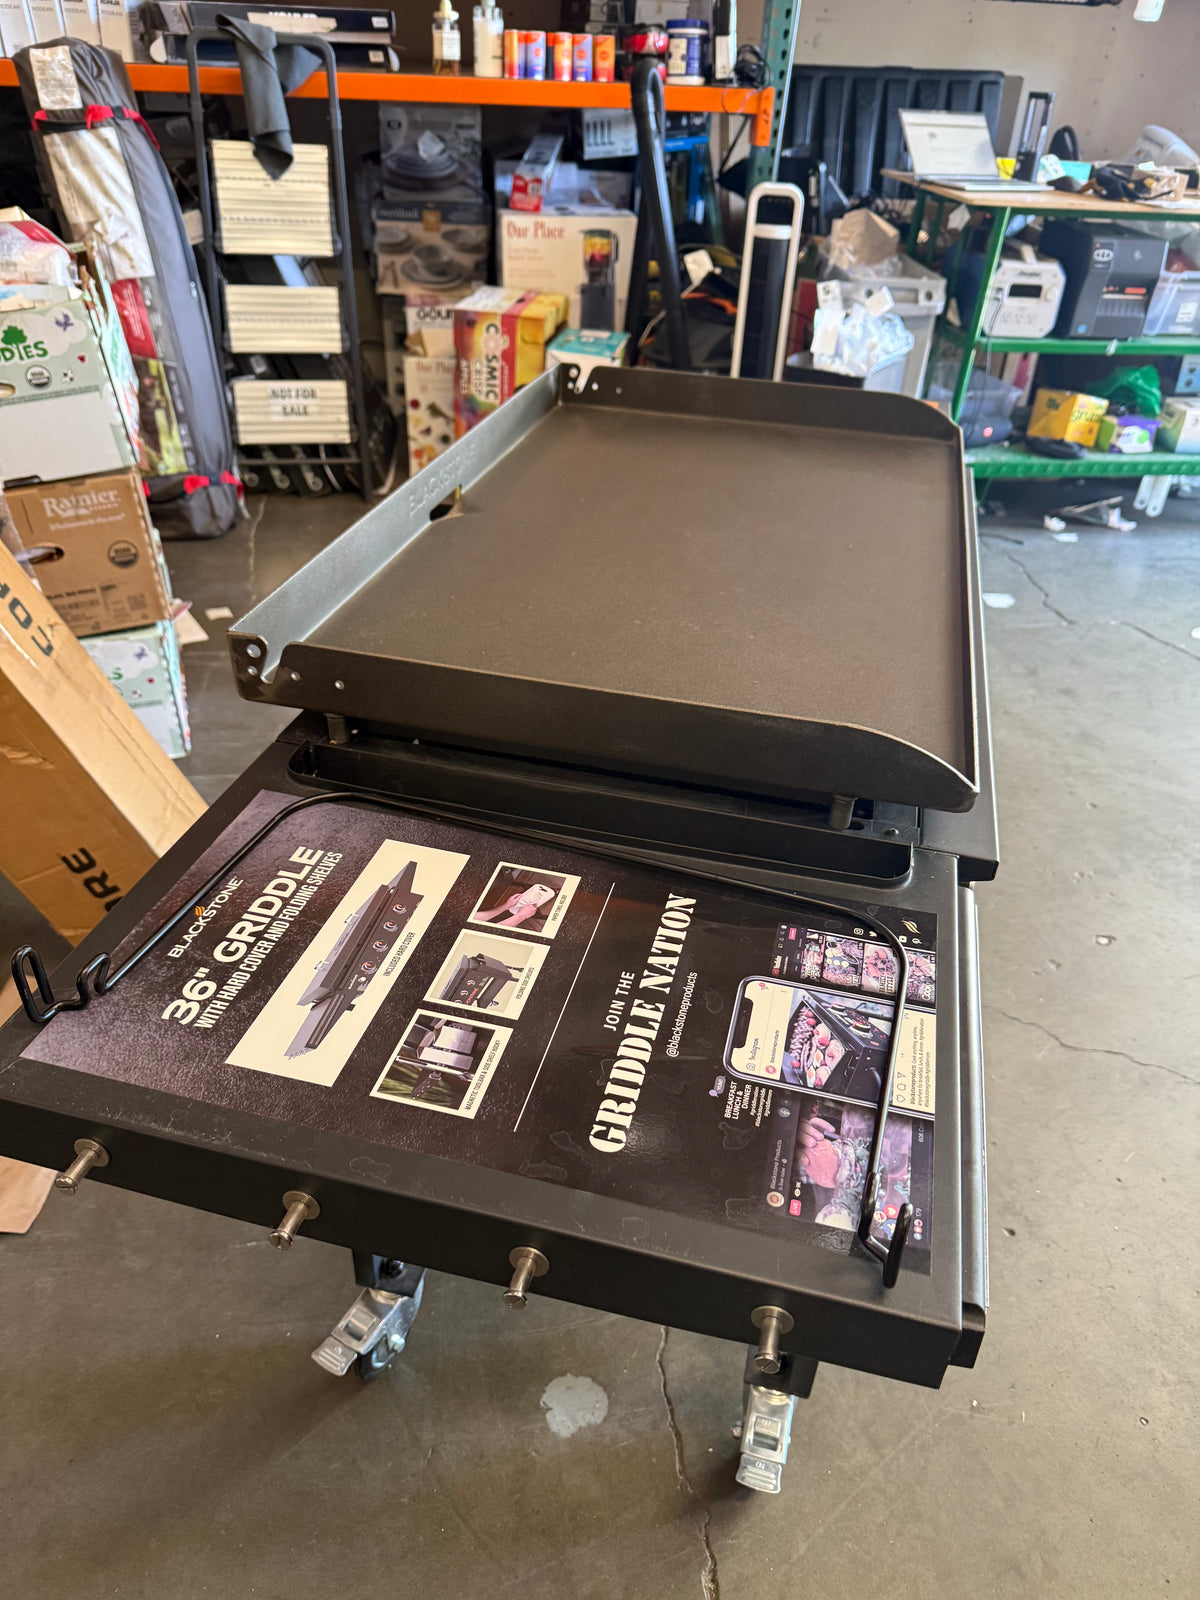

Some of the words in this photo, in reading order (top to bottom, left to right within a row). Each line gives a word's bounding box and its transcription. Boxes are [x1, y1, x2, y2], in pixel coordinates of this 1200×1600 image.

[507, 221, 528, 238] Our
[534, 221, 565, 239] Place
[270, 388, 292, 400] NOT
[296, 388, 318, 400] FOR
[282, 405, 310, 417] SALE
[42, 490, 119, 517] Rainier
[168, 876, 243, 958] BLACKSTONE
[162, 967, 217, 1025] 36"
[213, 847, 324, 963] GRIDDLE
[194, 995, 229, 1028] WITH
[219, 971, 251, 1004] HARD
[245, 940, 273, 971] COVER
[267, 917, 289, 945] AND
[279, 884, 318, 922] FOLDING
[308, 851, 344, 886] SHELVES
[383, 956, 401, 976] INCLUDED
[395, 944, 407, 957] HARD
[402, 932, 415, 945] COVER
[603, 1000, 626, 1031] JOIN
[615, 970, 635, 996] THE
[666, 971, 698, 1057] @blackstoneproducts
[589, 999, 666, 1153] GRIDDLE
[639, 893, 697, 994] NATION
[465, 1091, 478, 1110] MAGNETIC
[474, 1074, 486, 1090] TOOLBAR
[724, 1081, 738, 1118] BREAKFAST
[732, 1096, 742, 1120] LUNCH
[741, 1084, 752, 1109] DINNER
[750, 1086, 759, 1116] #griddlenation
[755, 1088, 766, 1127] #blackstonegriddle
[774, 1139, 782, 1161] Products
[770, 1162, 780, 1189] Blackstone
